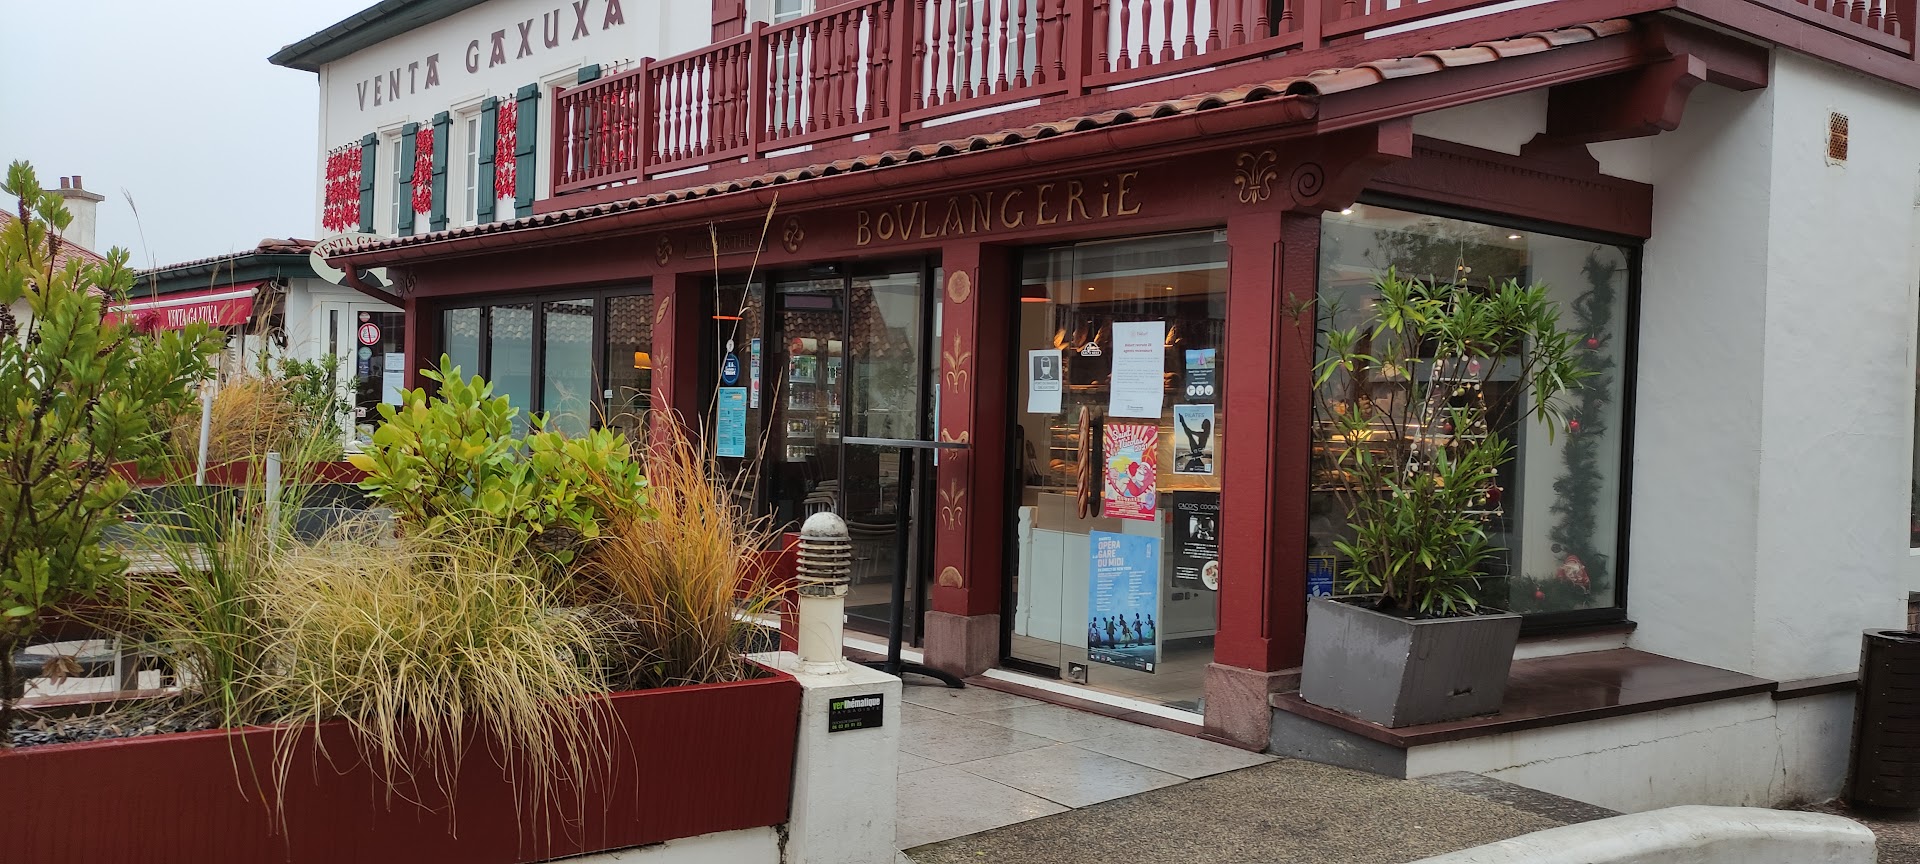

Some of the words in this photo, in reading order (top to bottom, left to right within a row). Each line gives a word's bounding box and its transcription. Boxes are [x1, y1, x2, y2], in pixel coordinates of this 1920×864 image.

[356, 53, 440, 111] VENTA
[465, 0, 625, 74] GAXUXA
[314, 237, 353, 258] VENTA
[167, 308, 186, 327] VENTA
[1112, 430, 1132, 441] Saint
[1118, 436, 1144, 448] Nicolas
[1097, 549, 1117, 559] GARE
[1097, 558, 1108, 568] DU
[1108, 557, 1124, 567] MIDI
[832, 707, 880, 715] PAYSAGISTE
